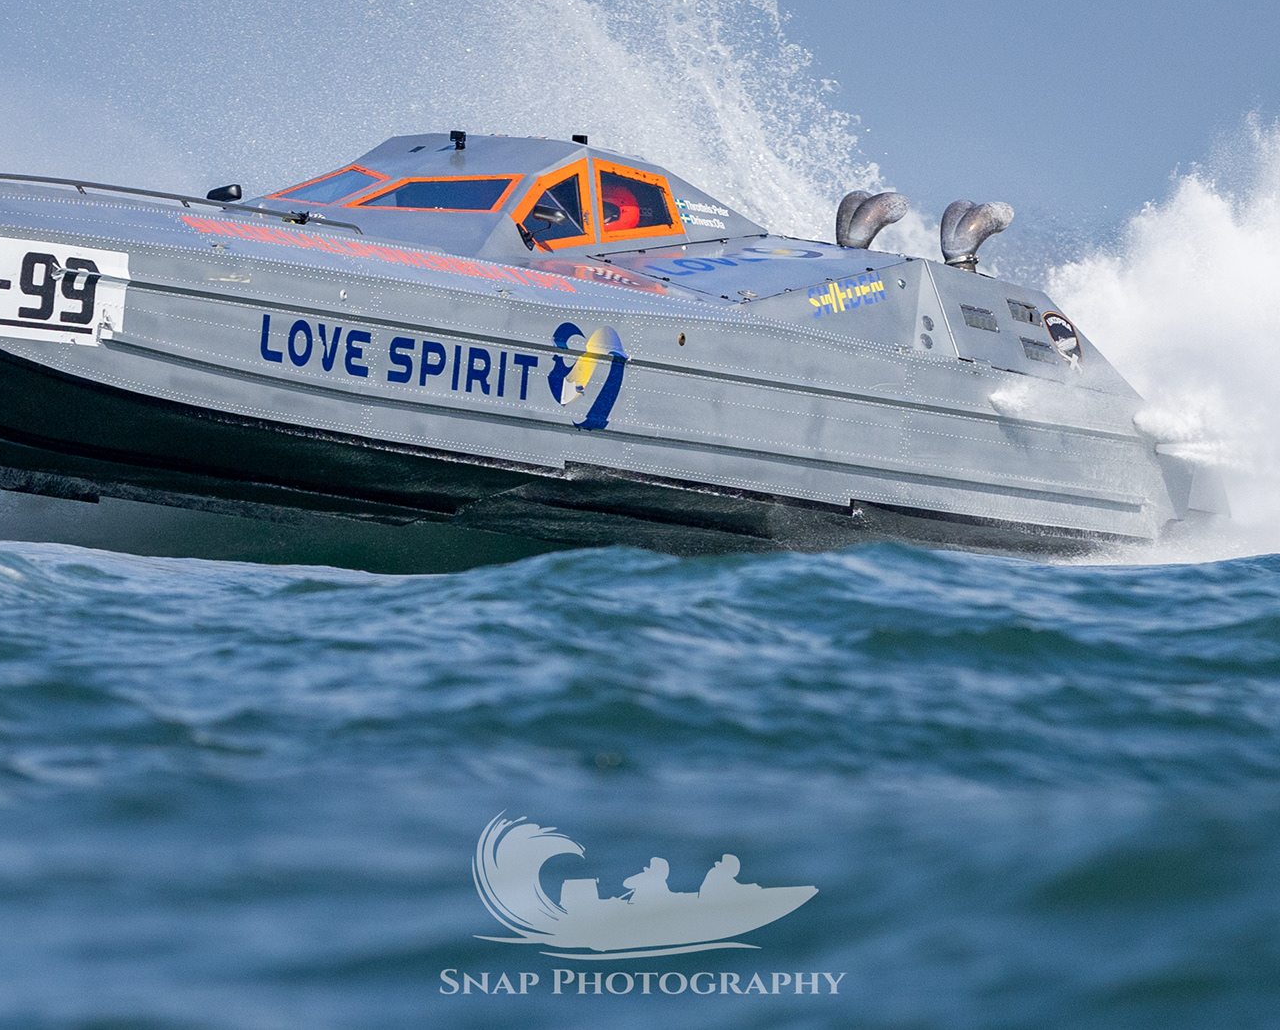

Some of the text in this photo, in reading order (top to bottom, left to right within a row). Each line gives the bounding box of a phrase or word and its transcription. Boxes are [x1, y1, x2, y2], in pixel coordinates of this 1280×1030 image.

[807, 271, 887, 319] SWEDEN
[260, 313, 539, 401] LOVE SPIRIT
